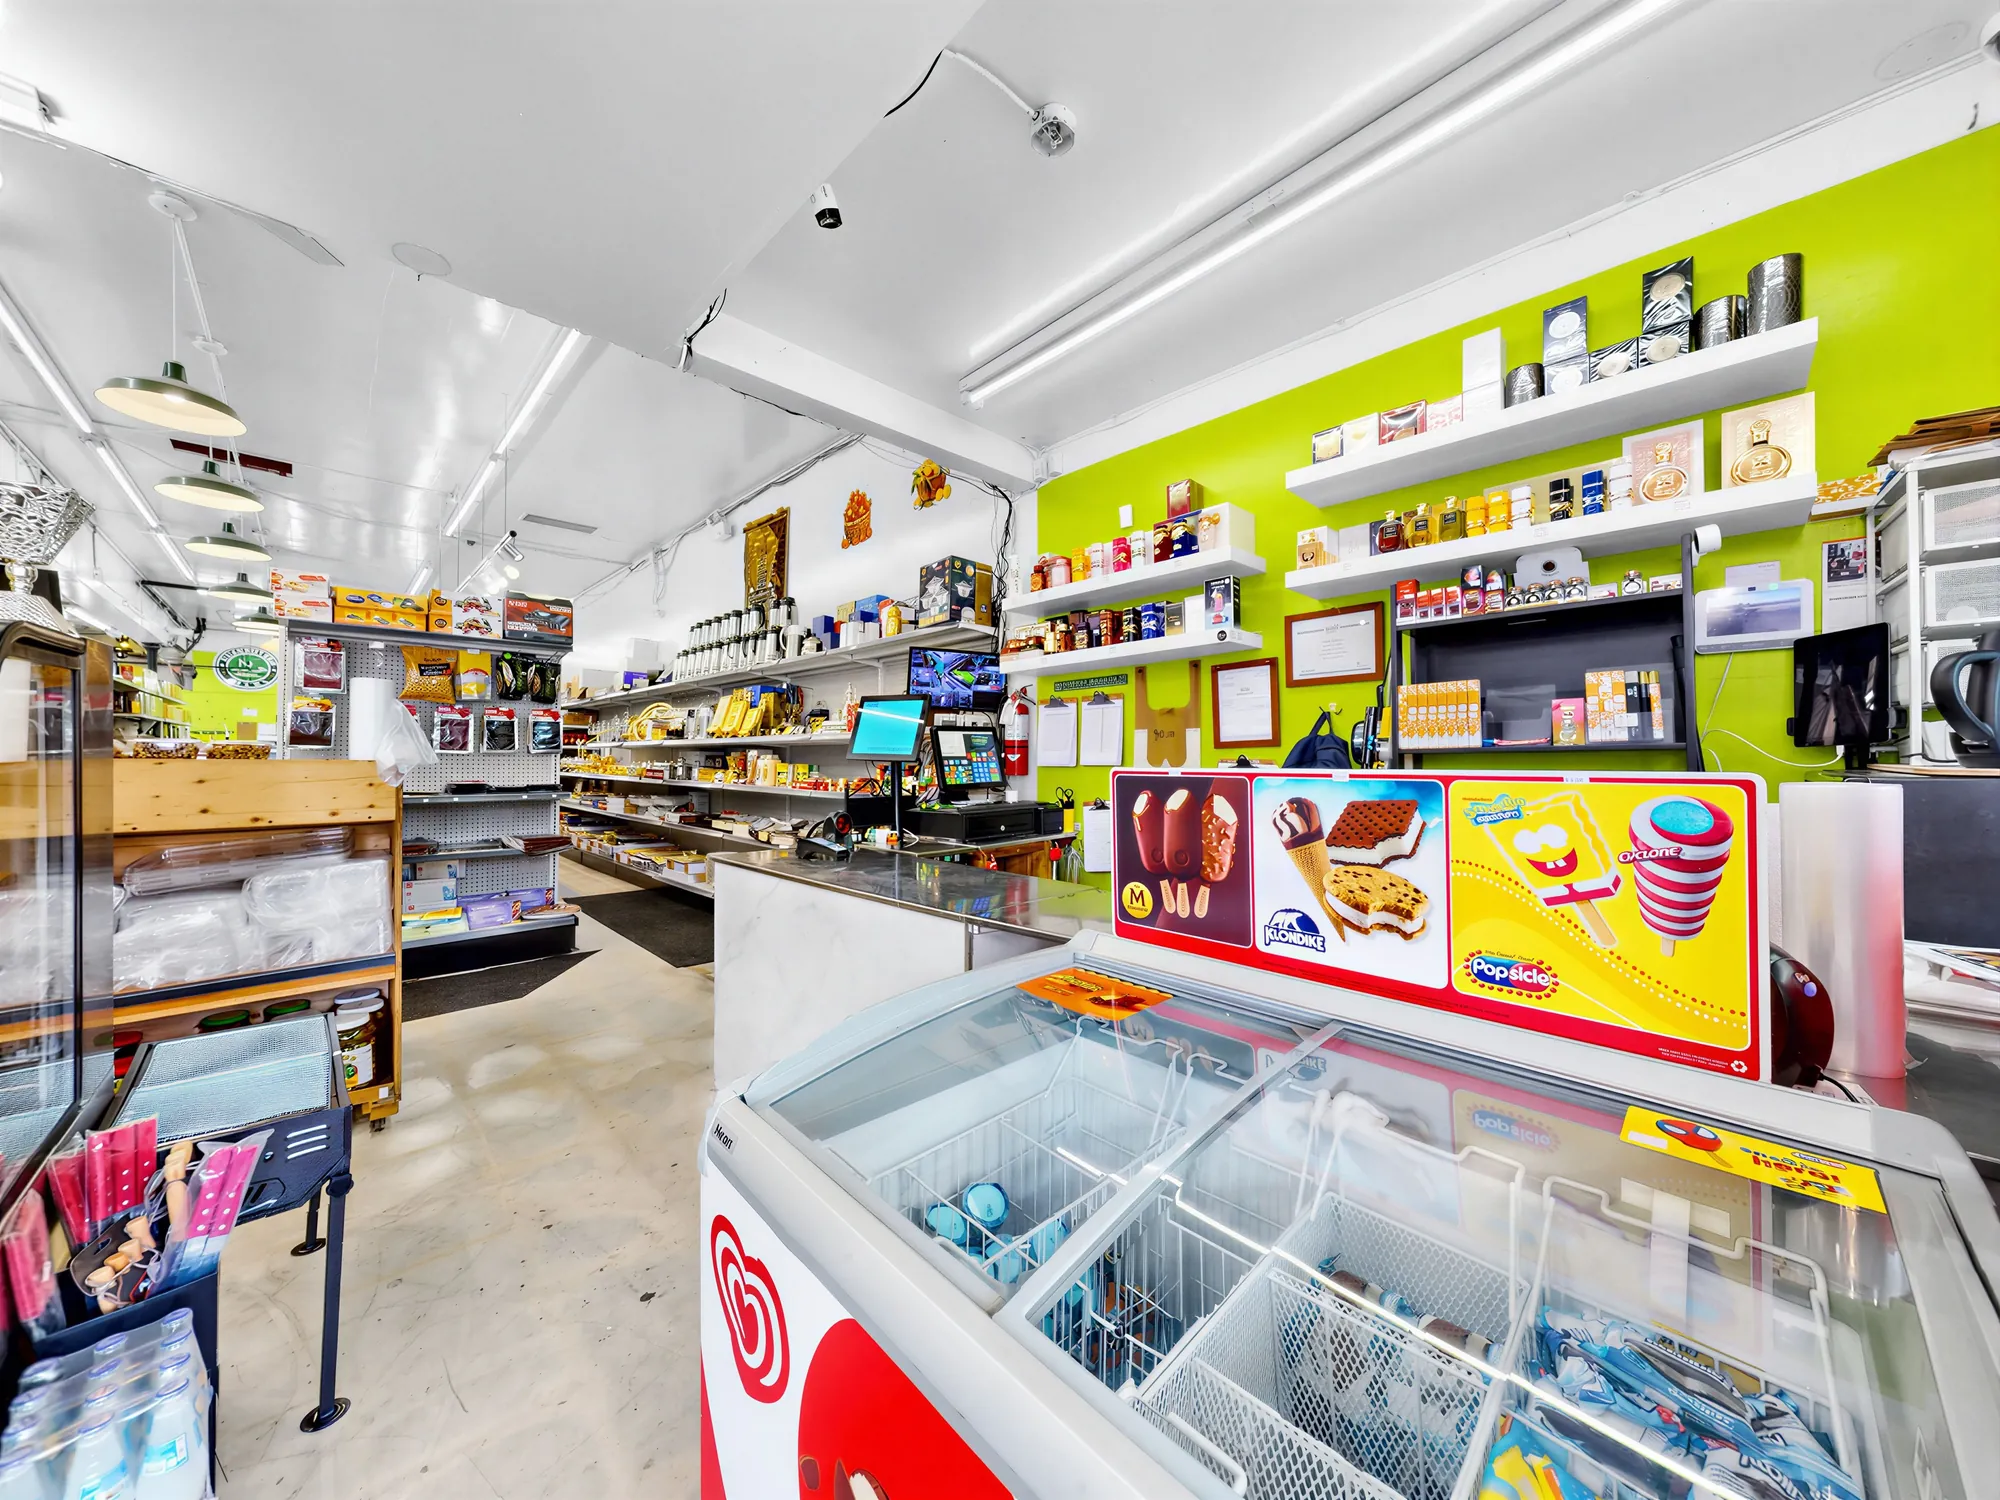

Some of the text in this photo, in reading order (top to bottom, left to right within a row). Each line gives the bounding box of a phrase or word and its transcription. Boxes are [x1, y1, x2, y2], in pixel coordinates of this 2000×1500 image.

[1129, 887, 1146, 907] M
[1264, 926, 1326, 952] KLONDIKE
[1472, 957, 1551, 987] Popsicle
